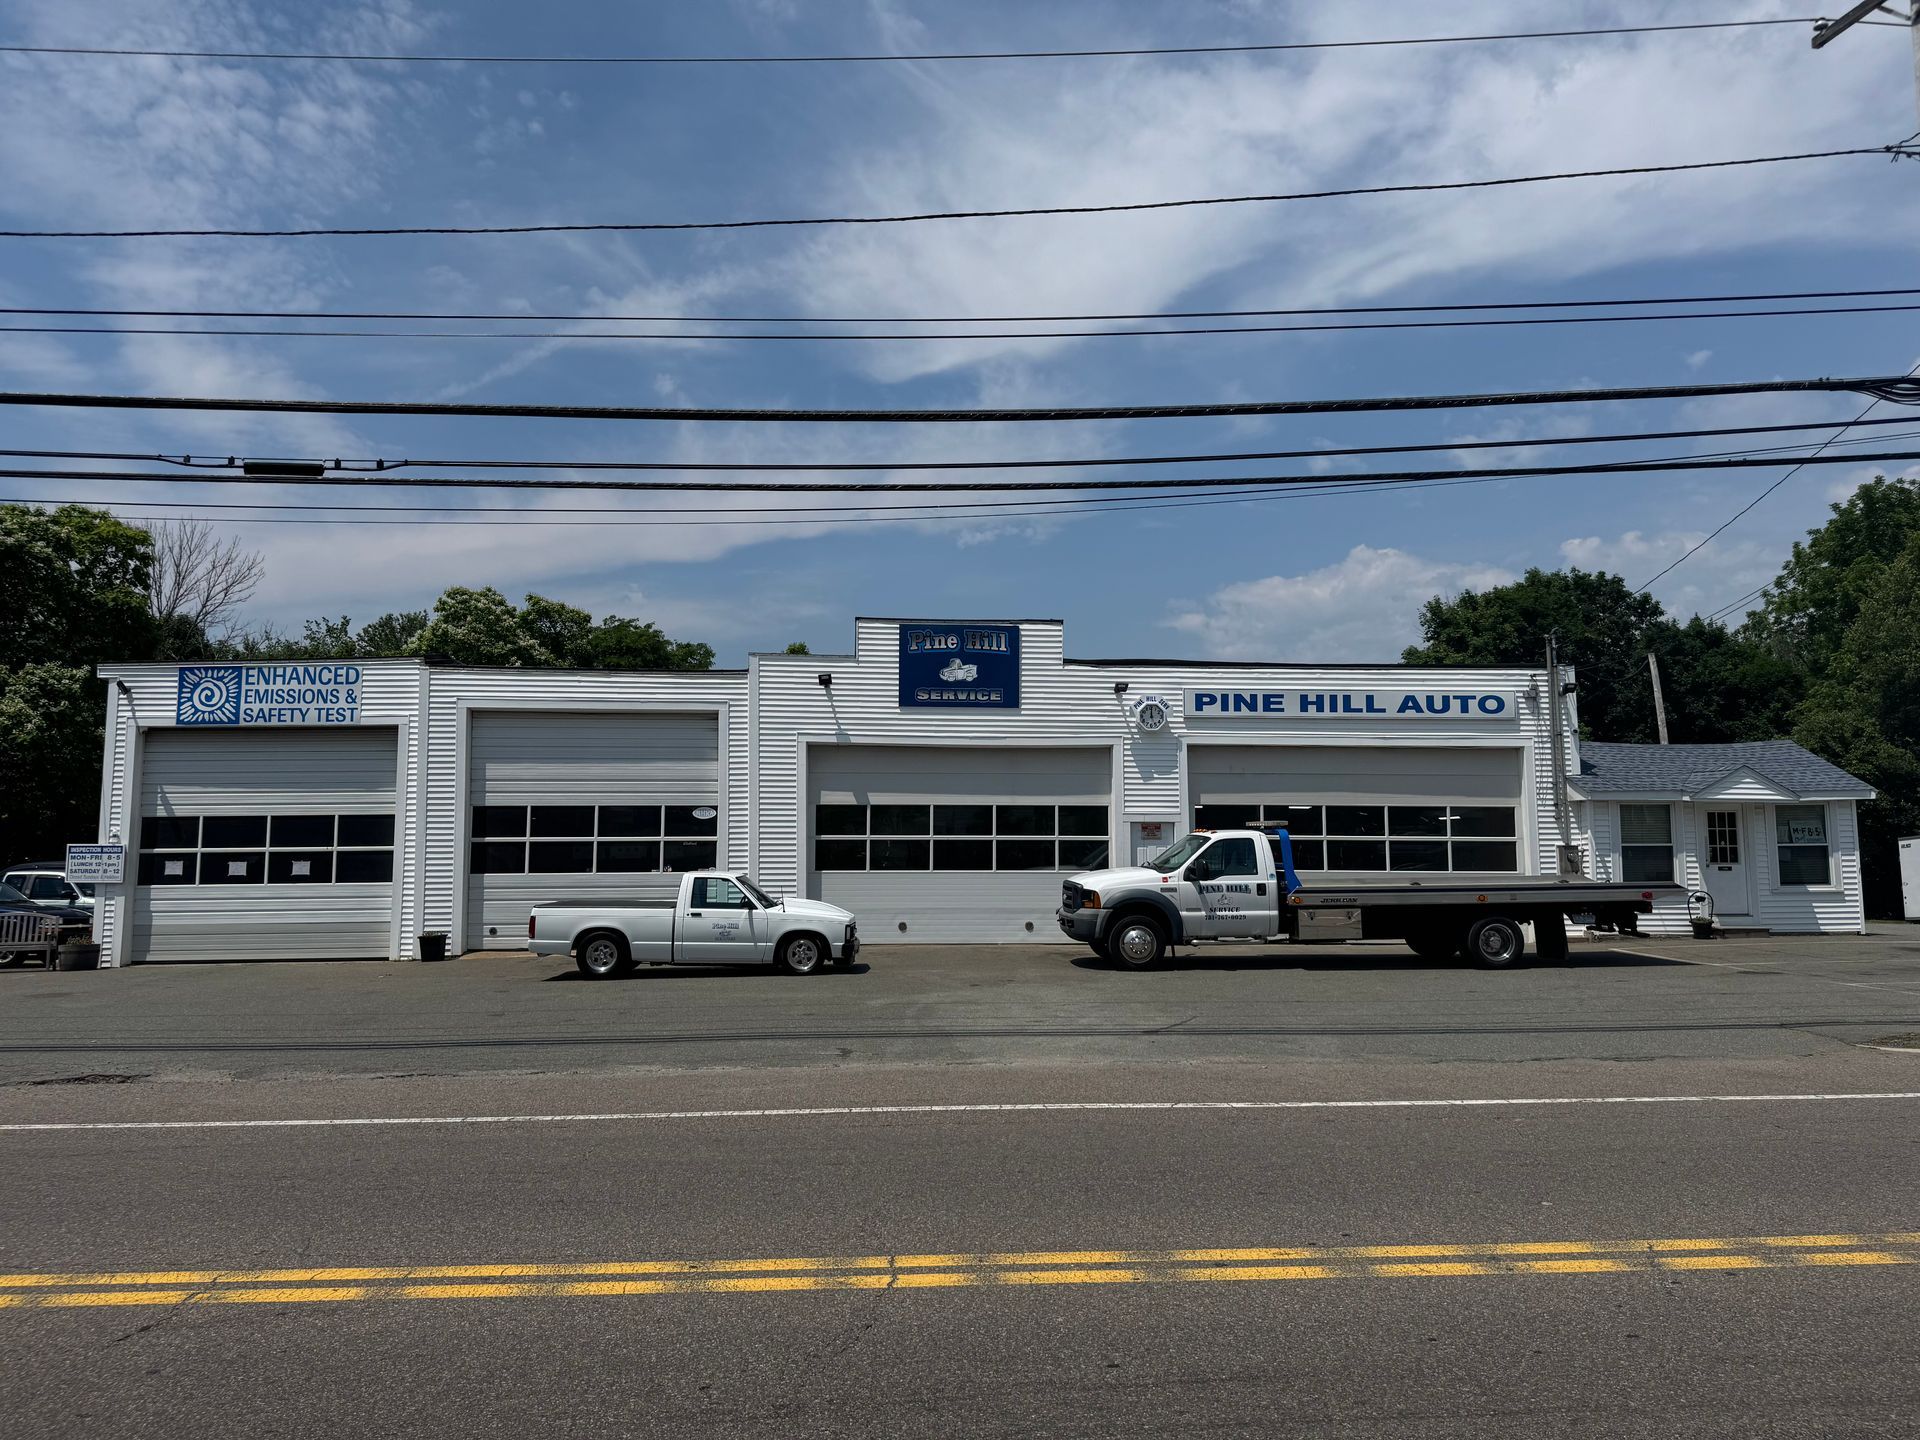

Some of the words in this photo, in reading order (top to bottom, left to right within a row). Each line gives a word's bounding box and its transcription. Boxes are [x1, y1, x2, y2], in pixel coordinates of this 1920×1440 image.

[908, 630, 959, 652] Pine
[964, 630, 1009, 653] Hill
[245, 666, 361, 685] ENHANCED
[244, 688, 340, 704] EMISSIONS
[344, 688, 358, 704] &
[916, 688, 1002, 702] SERVICE
[1133, 699, 1145, 710] PINE
[1194, 693, 1285, 713] PINE
[1299, 693, 1386, 714] HILL
[1396, 694, 1506, 715] AUTO
[242, 707, 311, 723] SAFETY
[314, 707, 359, 723] TEST
[1200, 884, 1223, 894] PINE
[1226, 884, 1251, 894] HILL
